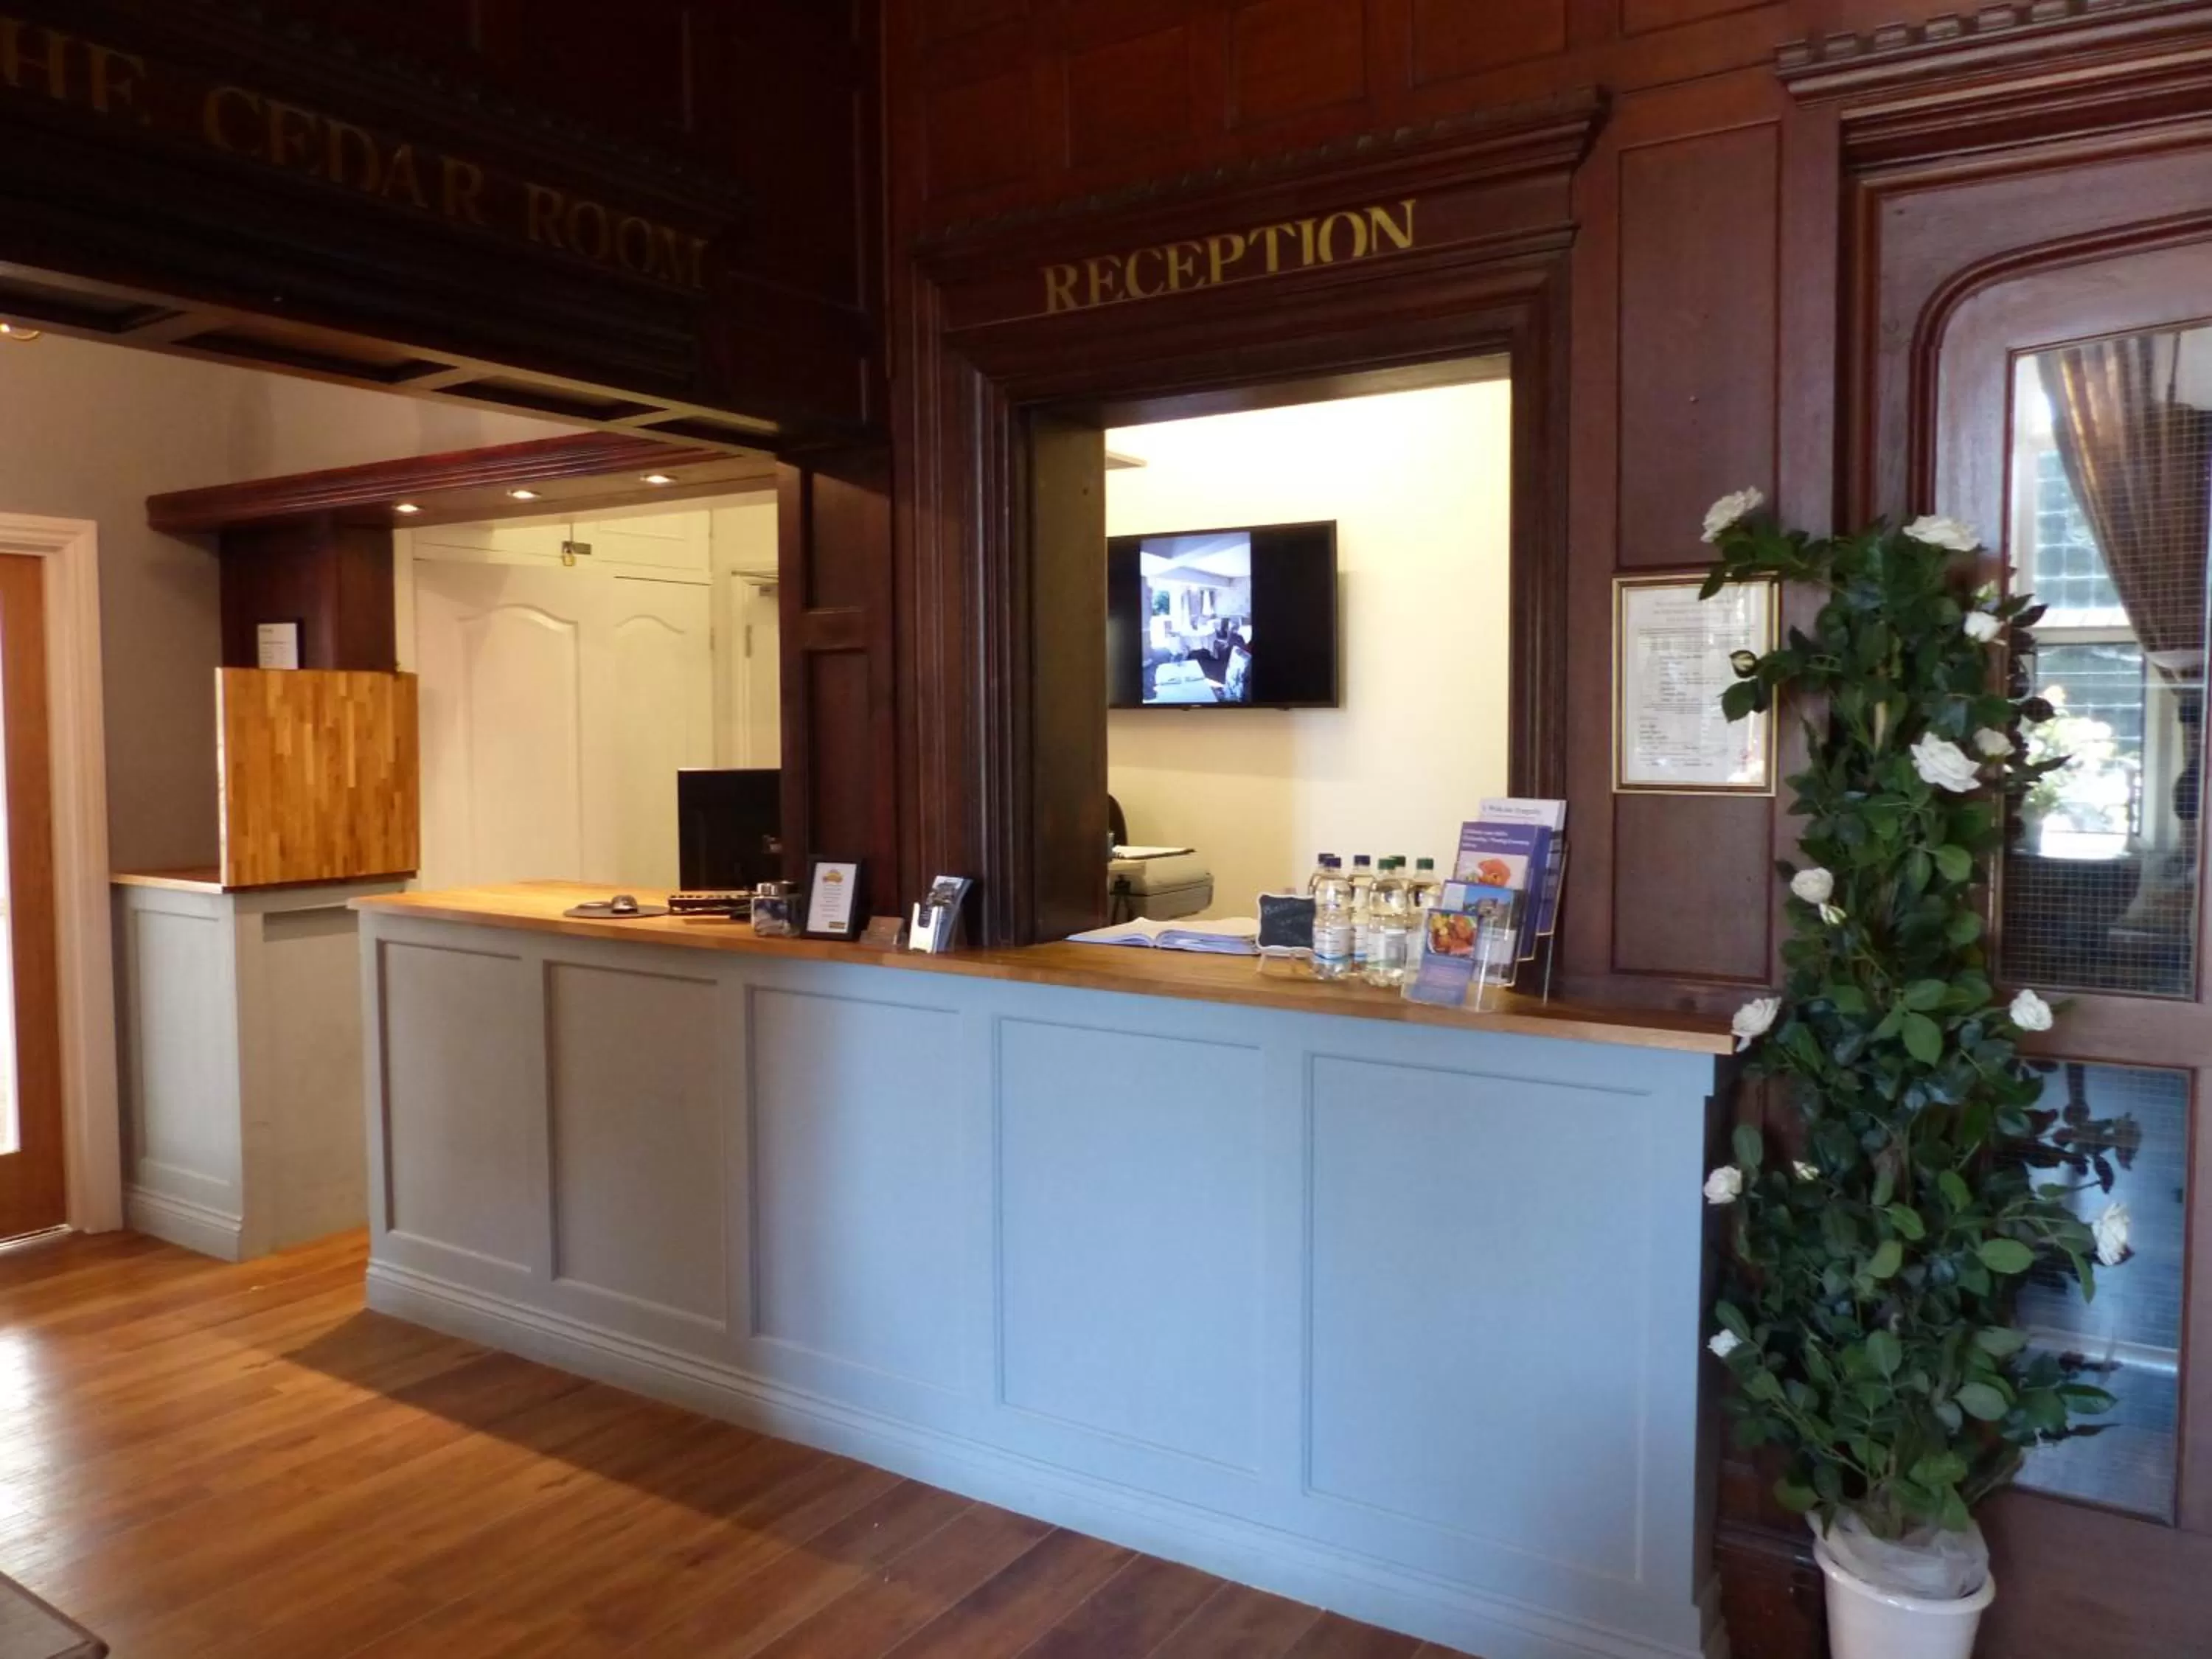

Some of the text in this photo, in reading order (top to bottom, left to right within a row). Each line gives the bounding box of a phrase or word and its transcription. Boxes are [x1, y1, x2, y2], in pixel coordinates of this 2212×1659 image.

[0, 15, 708, 291] HE CEDAR ROOM
[1039, 198, 1416, 313] RECEPTION
